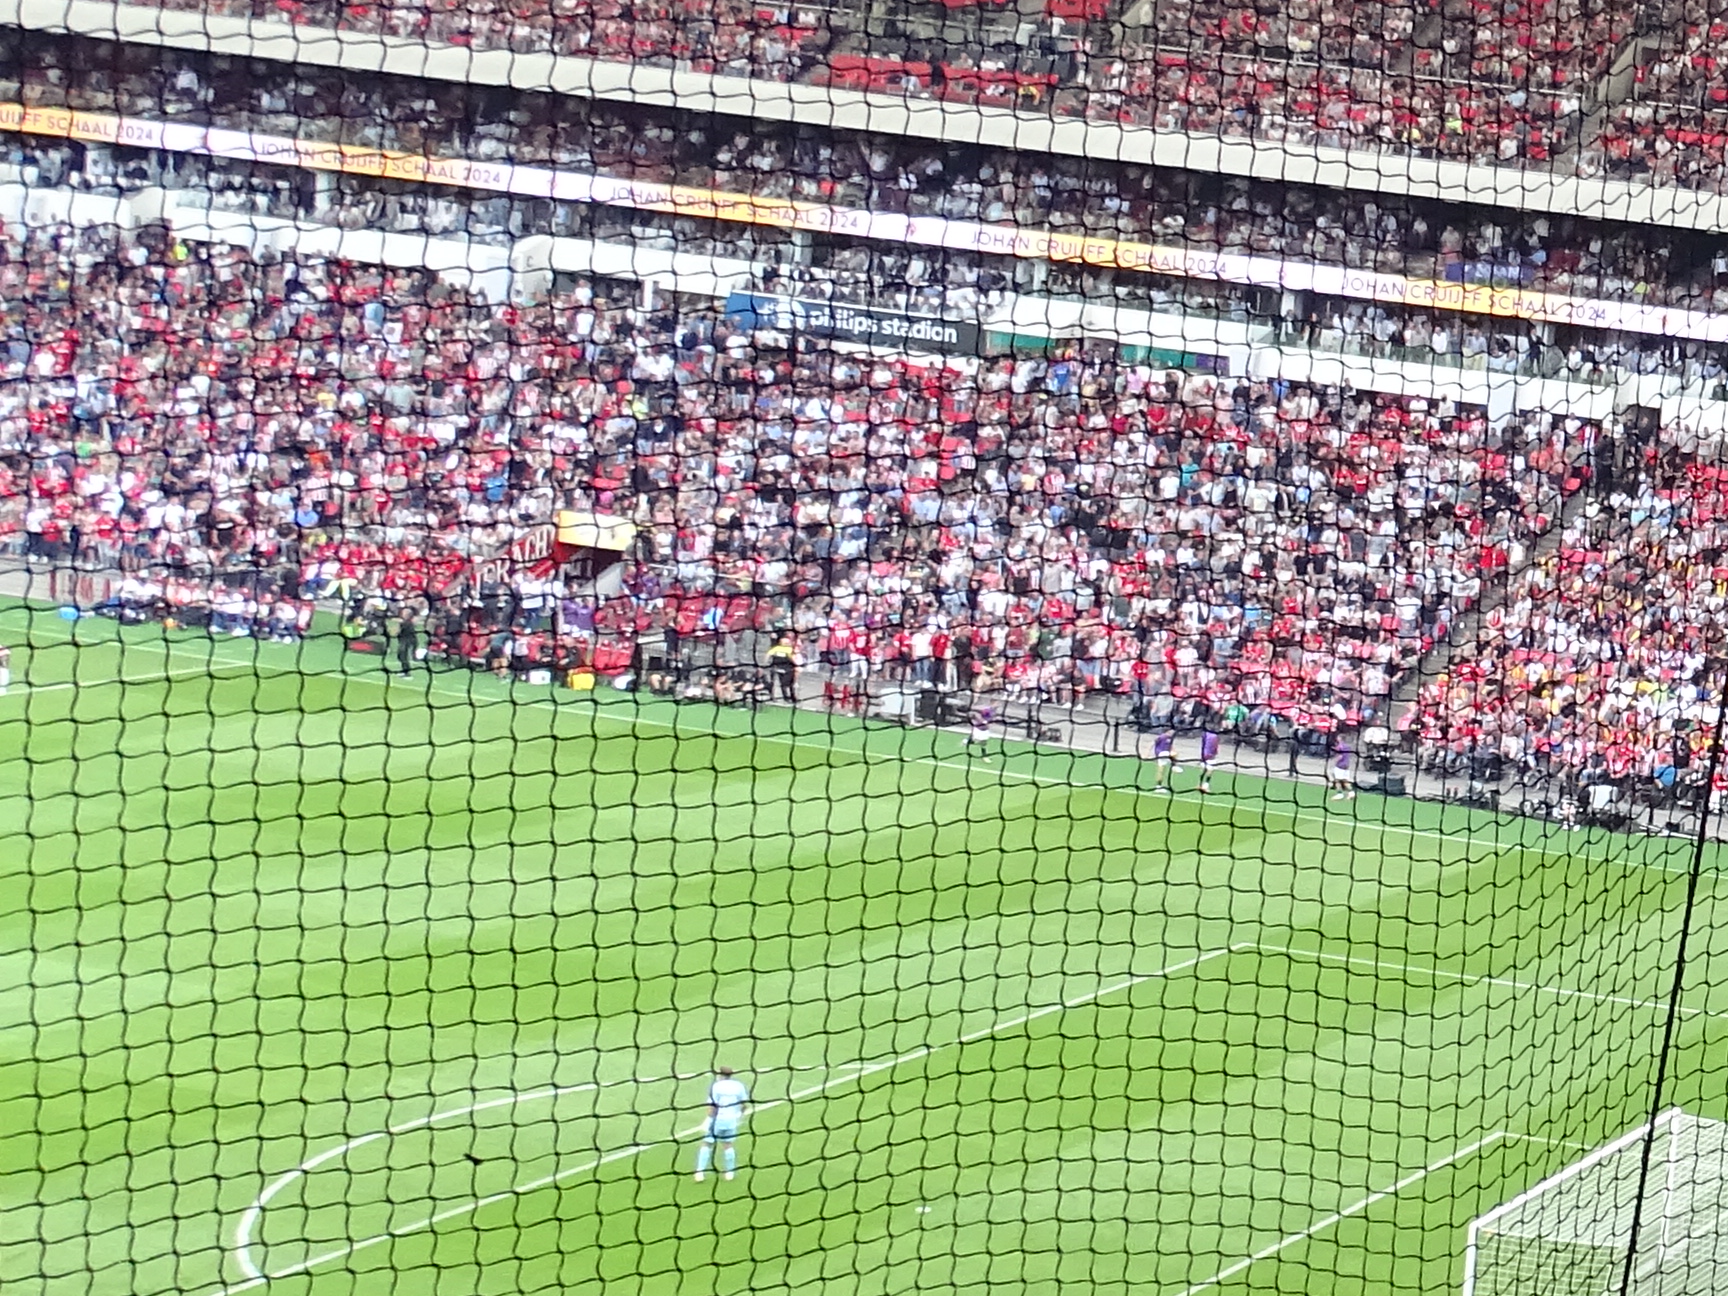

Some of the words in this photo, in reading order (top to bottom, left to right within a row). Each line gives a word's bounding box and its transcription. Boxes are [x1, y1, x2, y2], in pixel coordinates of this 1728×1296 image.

[47, 116, 111, 137] SCHAAL
[117, 125, 153, 142] 2024
[260, 141, 317, 162] JOHAN
[392, 159, 456, 180] SCHAAL
[463, 166, 501, 185] 2024
[610, 186, 669, 205] JOHAN
[746, 204, 813, 225] SCHAAL
[820, 211, 859, 229] 2024
[971, 230, 1030, 250] JOHAN
[1112, 246, 1180, 271] SCHAAL
[1187, 256, 1227, 275] 2024
[1342, 276, 1404, 297] JOHAN
[1410, 284, 1482, 307] CRUIJFF
[1489, 294, 1557, 317] SCHAAL
[1563, 302, 1607, 322] 2024
[809, 309, 879, 335] philips
[881, 317, 958, 344] stadion
